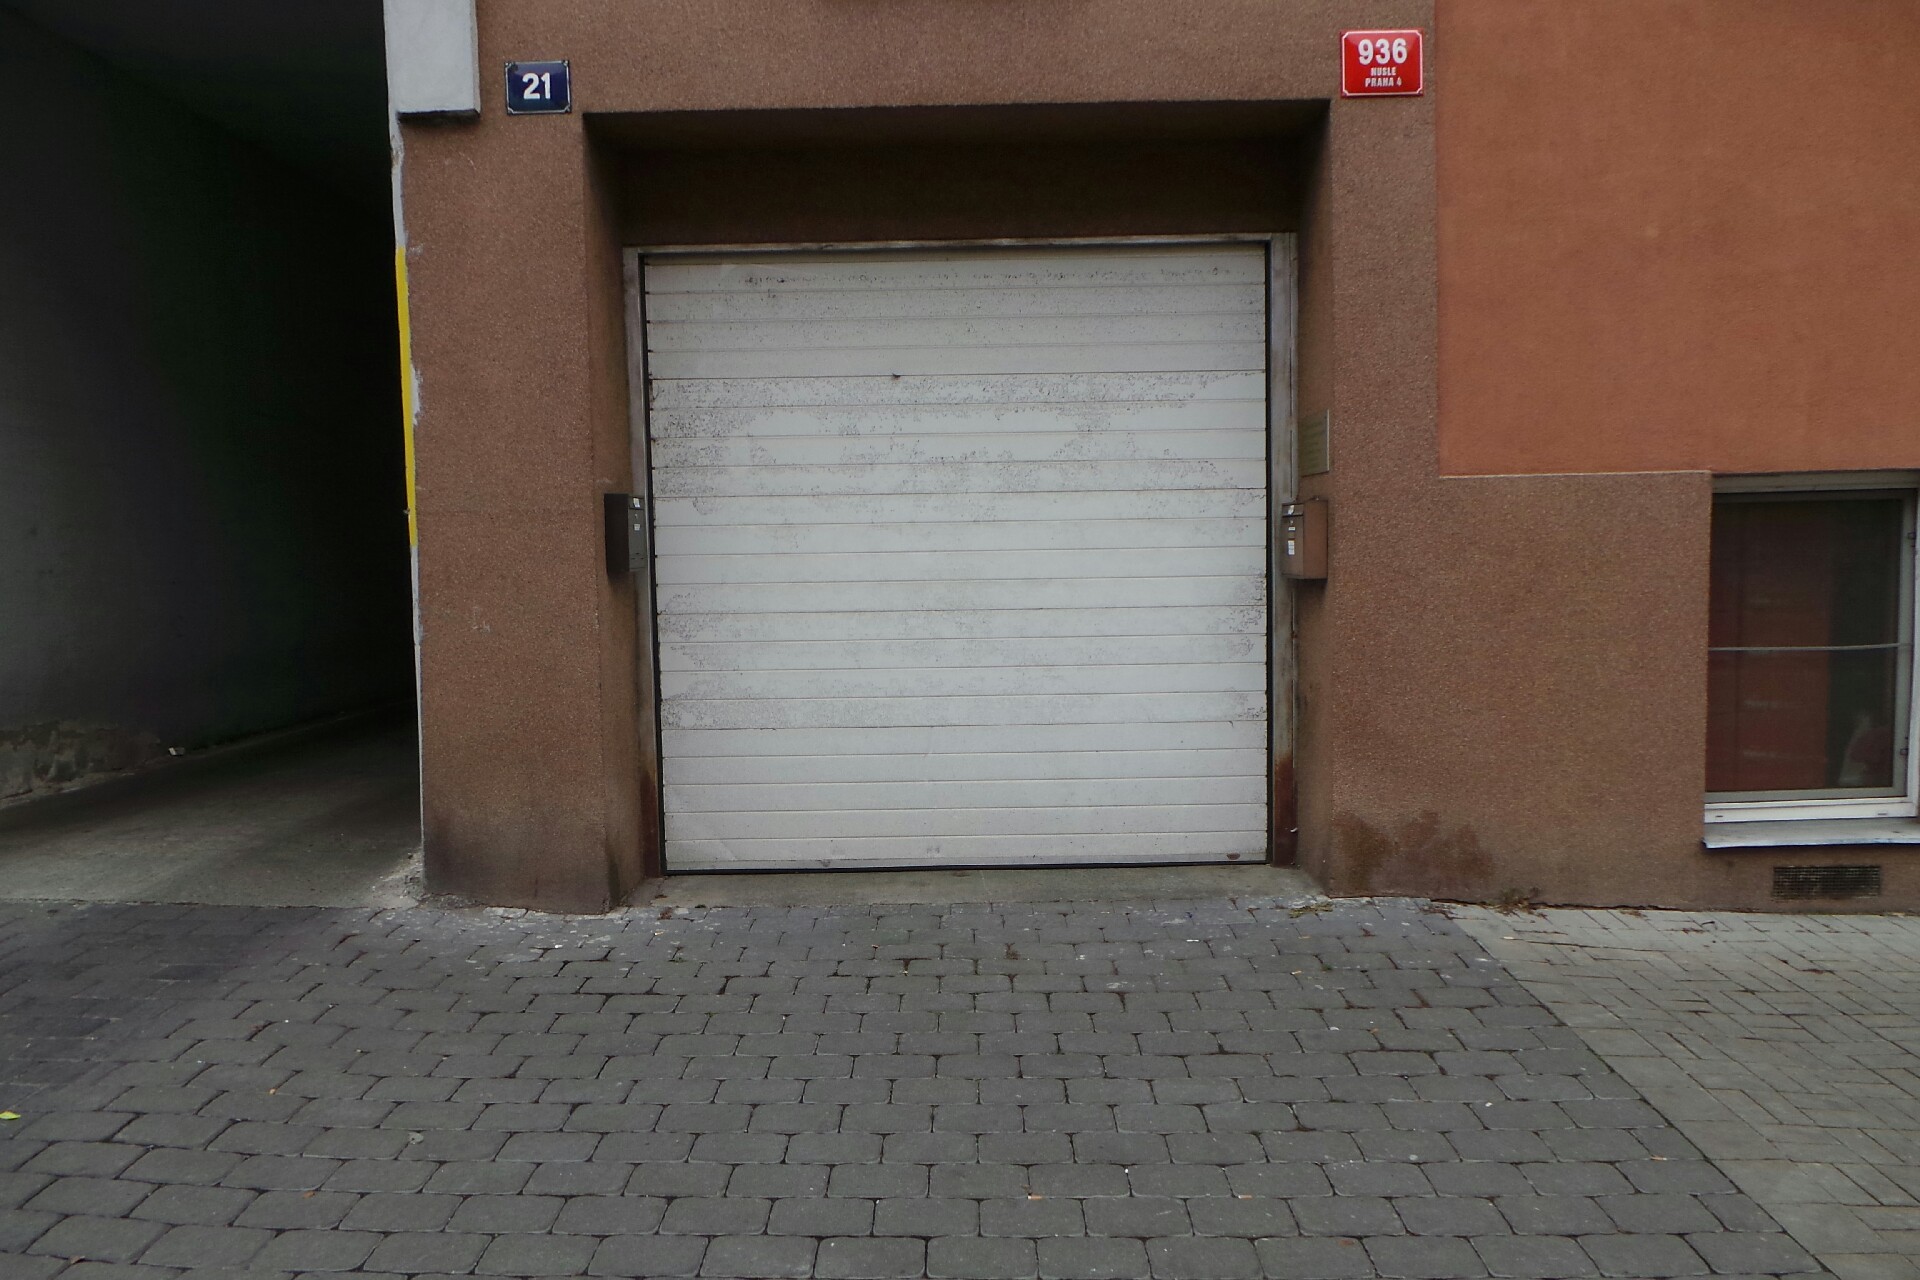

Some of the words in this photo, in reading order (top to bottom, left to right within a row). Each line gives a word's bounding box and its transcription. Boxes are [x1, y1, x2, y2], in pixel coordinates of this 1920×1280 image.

[1358, 38, 1407, 65] 936
[1371, 67, 1396, 76] NUSLE
[522, 72, 551, 100] 21
[1365, 77, 1394, 87] PRAHA
[1396, 77, 1402, 86] 4
